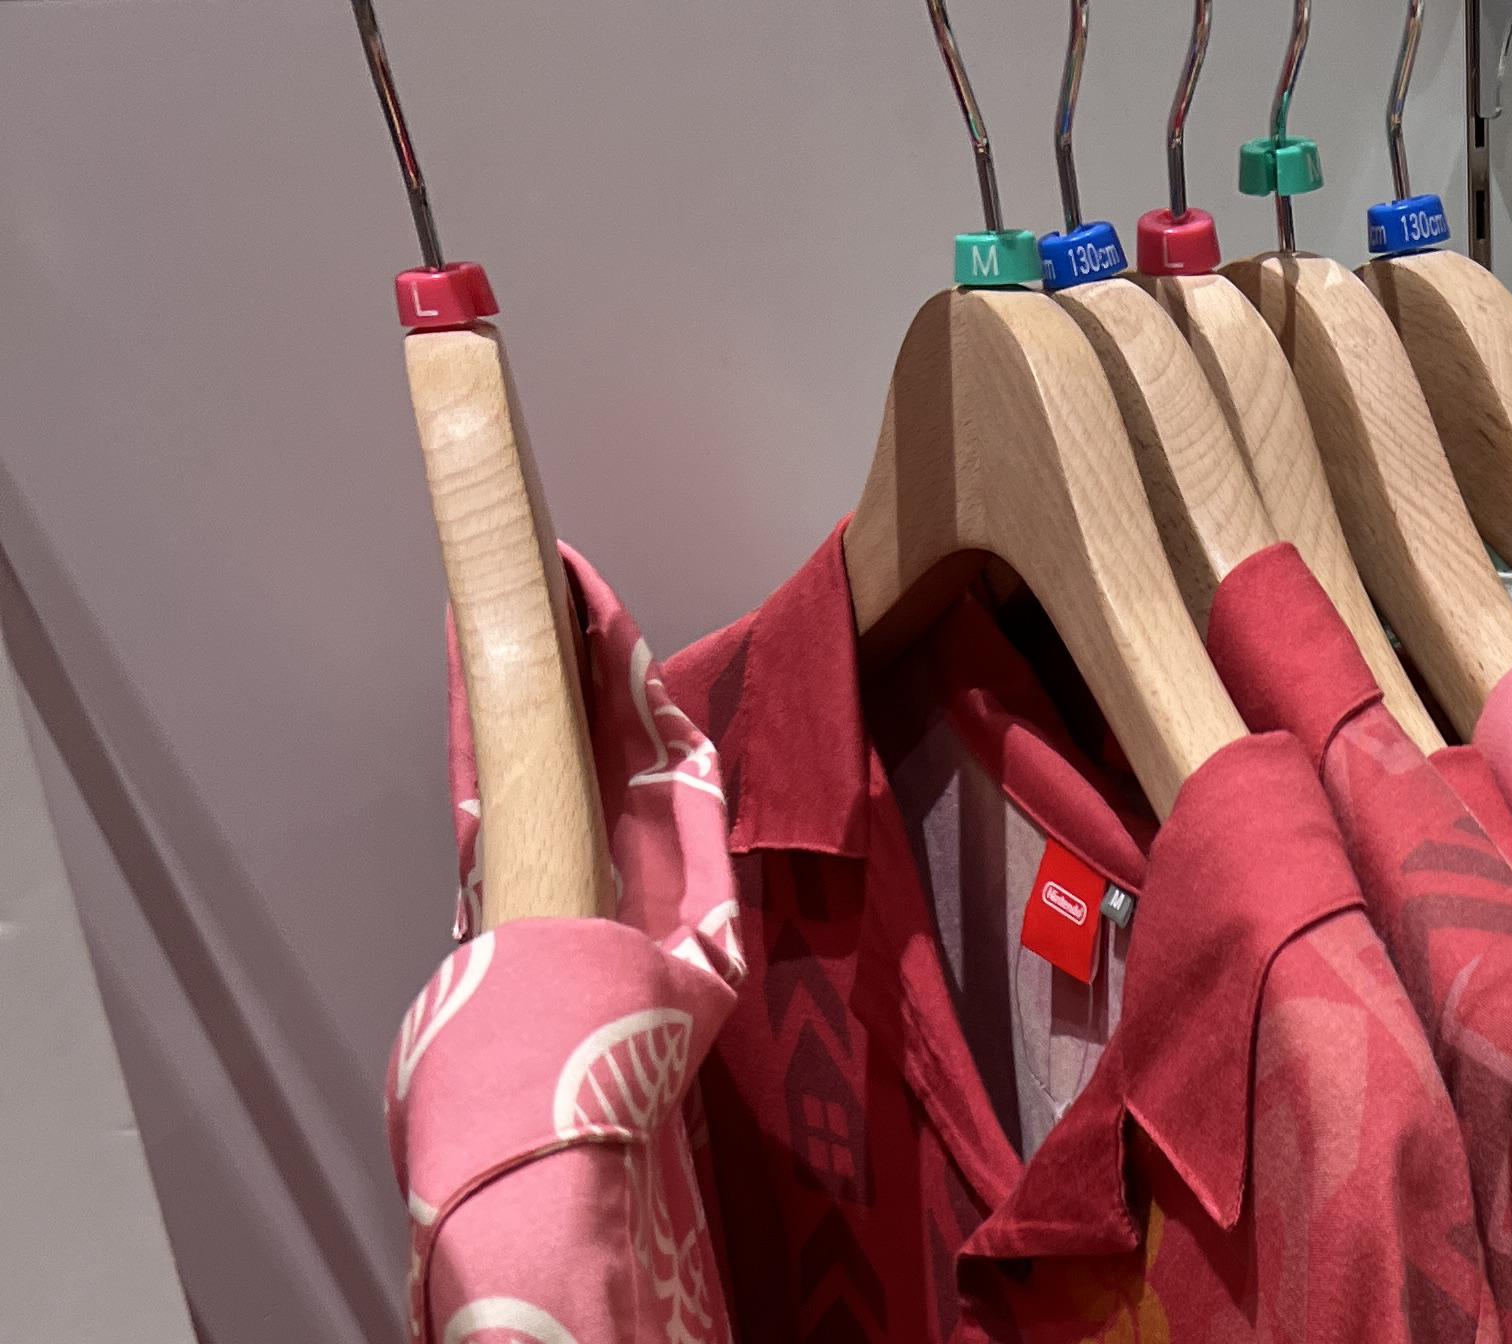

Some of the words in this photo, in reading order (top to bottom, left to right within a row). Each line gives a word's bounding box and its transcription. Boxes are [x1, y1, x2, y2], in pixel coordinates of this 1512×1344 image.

[1400, 210, 1447, 242] 130cm
[972, 244, 999, 278] M
[1067, 242, 1121, 277] 130cm
[1163, 231, 1184, 269] L
[411, 280, 439, 317] L
[1109, 888, 1126, 911] M
